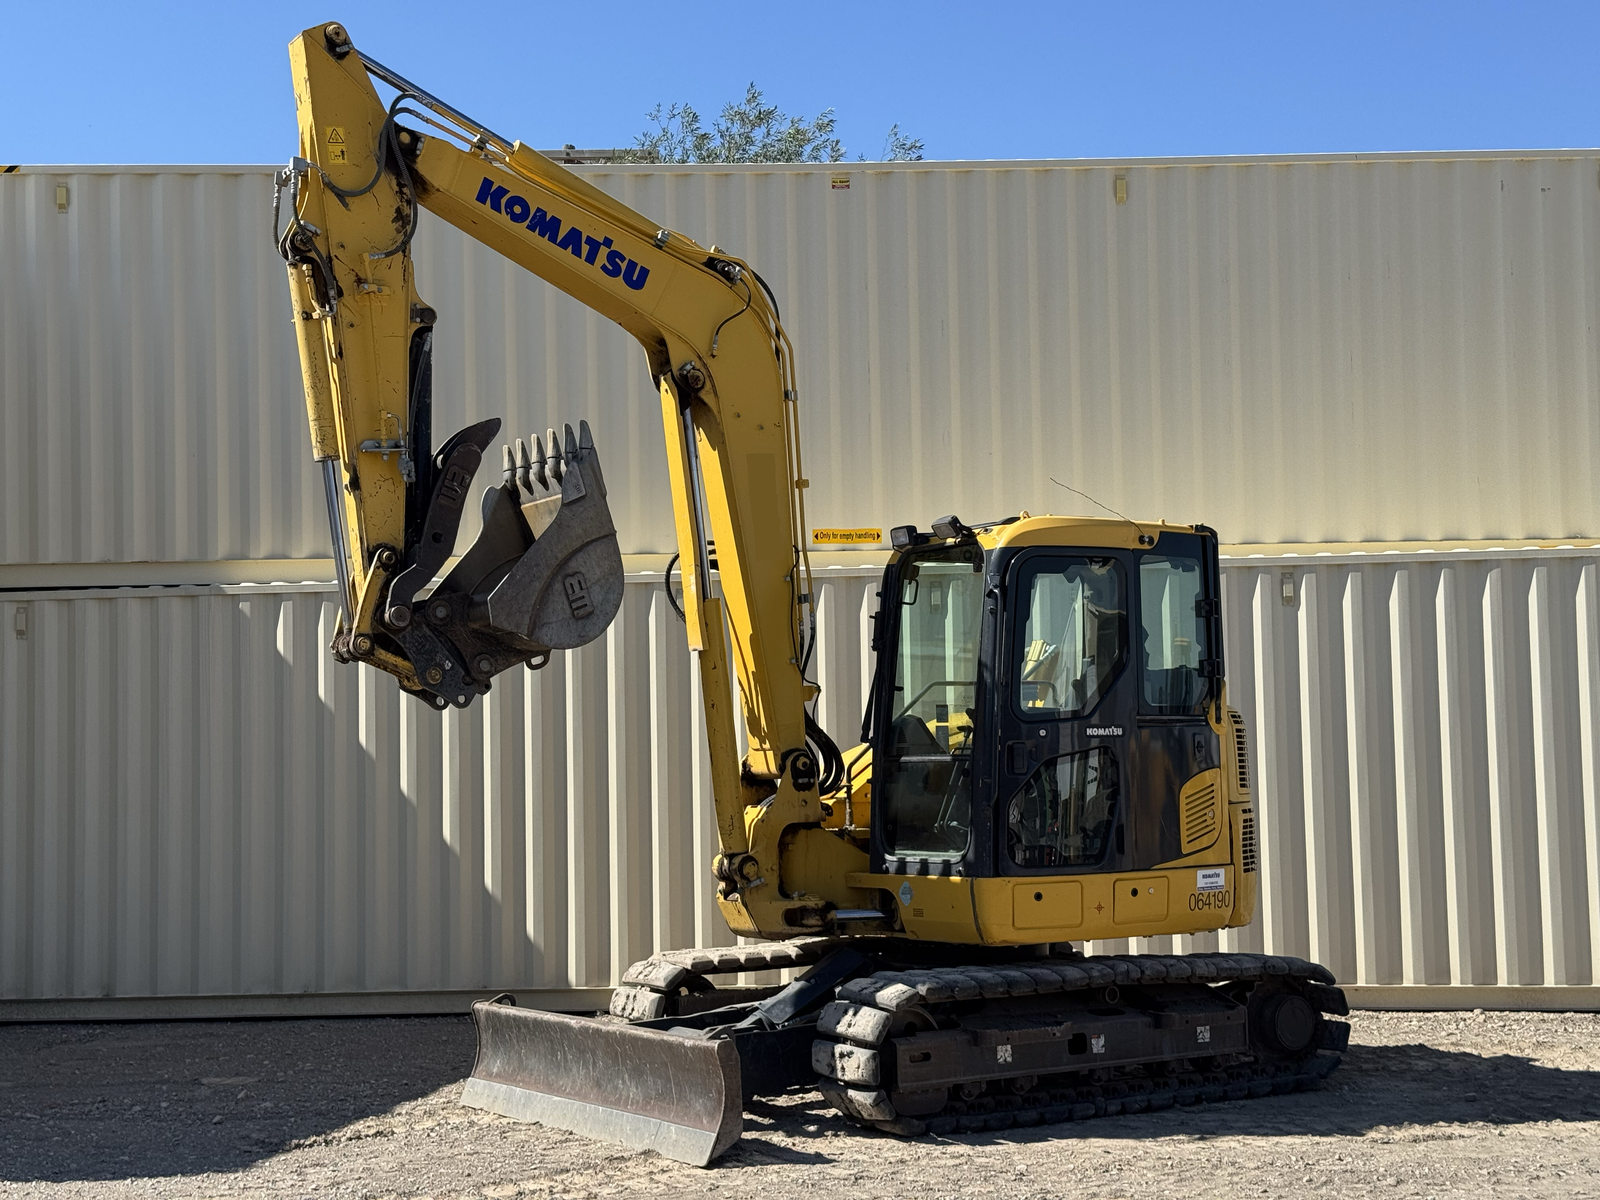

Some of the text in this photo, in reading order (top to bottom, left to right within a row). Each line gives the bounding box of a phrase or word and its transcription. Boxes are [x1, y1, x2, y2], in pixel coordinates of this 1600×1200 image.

[475, 177, 650, 290] KOMATSU
[819, 531, 831, 541] Only
[840, 532, 854, 541] empty
[855, 531, 876, 541] handling
[1086, 726, 1122, 736] KOMATSU
[1189, 890, 1230, 911] 064190
